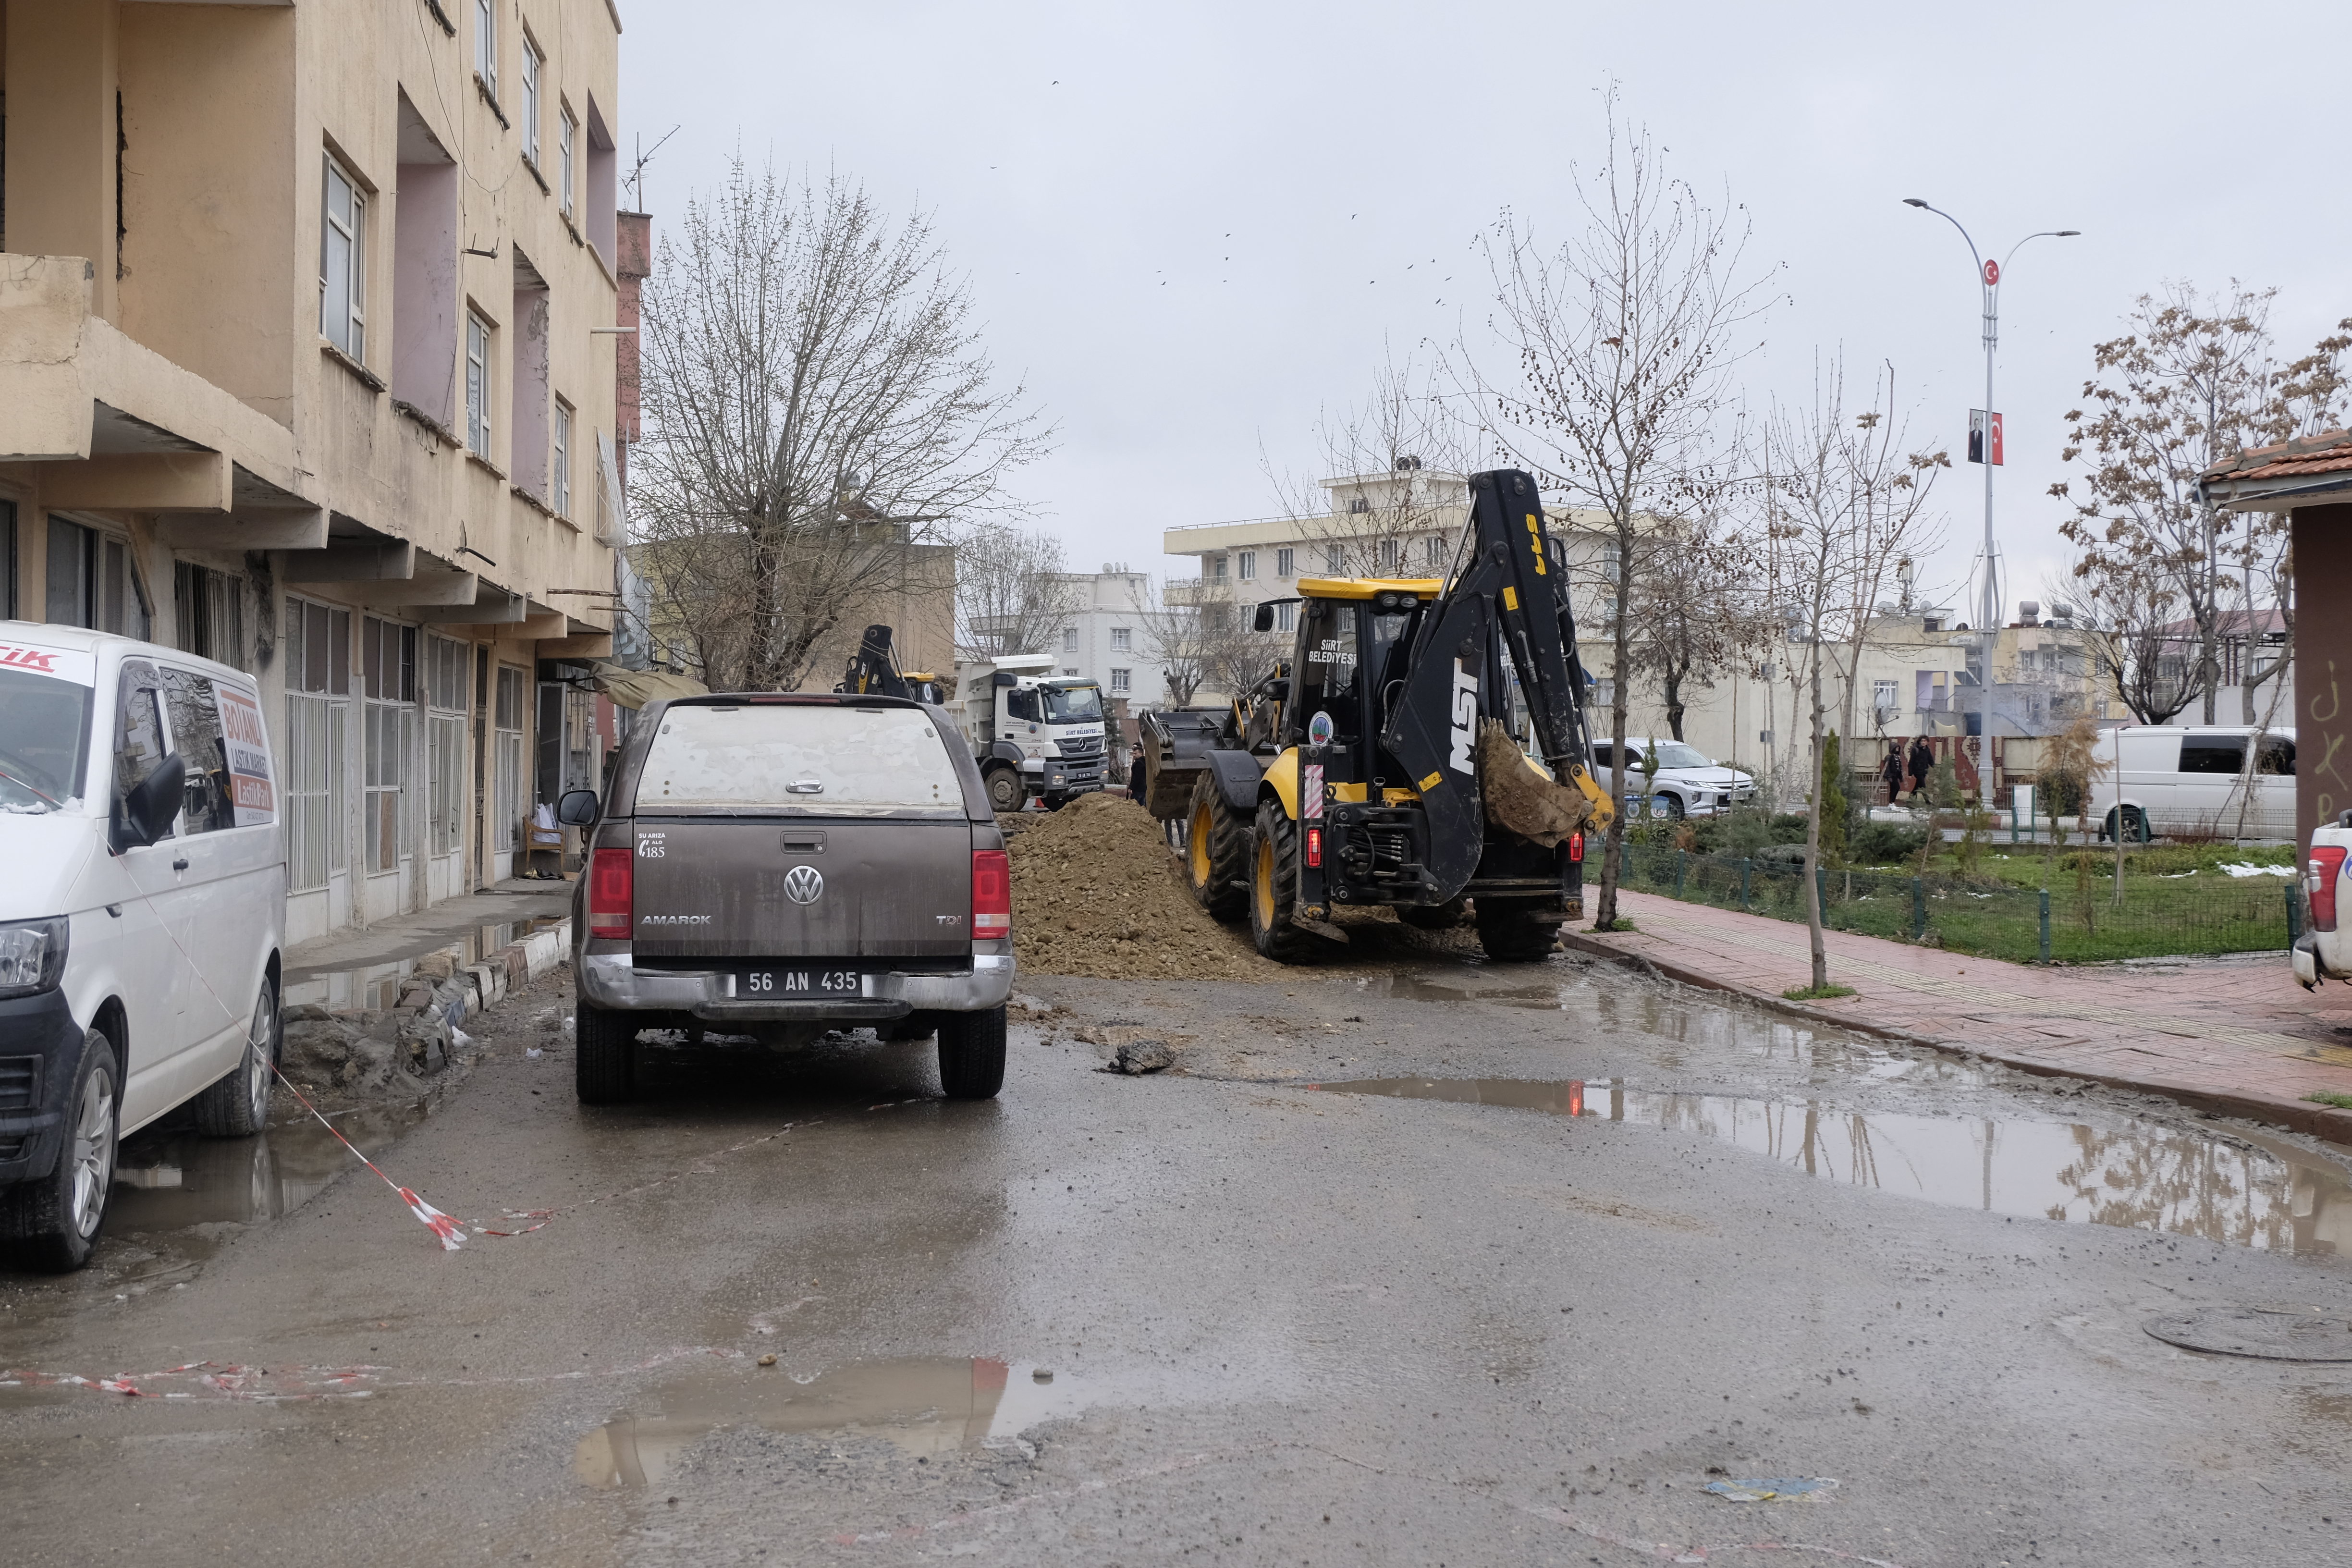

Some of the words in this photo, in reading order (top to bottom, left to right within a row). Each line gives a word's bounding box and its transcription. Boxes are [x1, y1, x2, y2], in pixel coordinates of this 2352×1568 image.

[1449, 657, 1478, 776] MST
[646, 847, 665, 858] 185
[640, 915, 711, 925] AMAROK
[936, 915, 962, 925] TDI
[749, 973, 772, 991] 56
[785, 972, 808, 991] AN
[821, 971, 857, 990] 435
